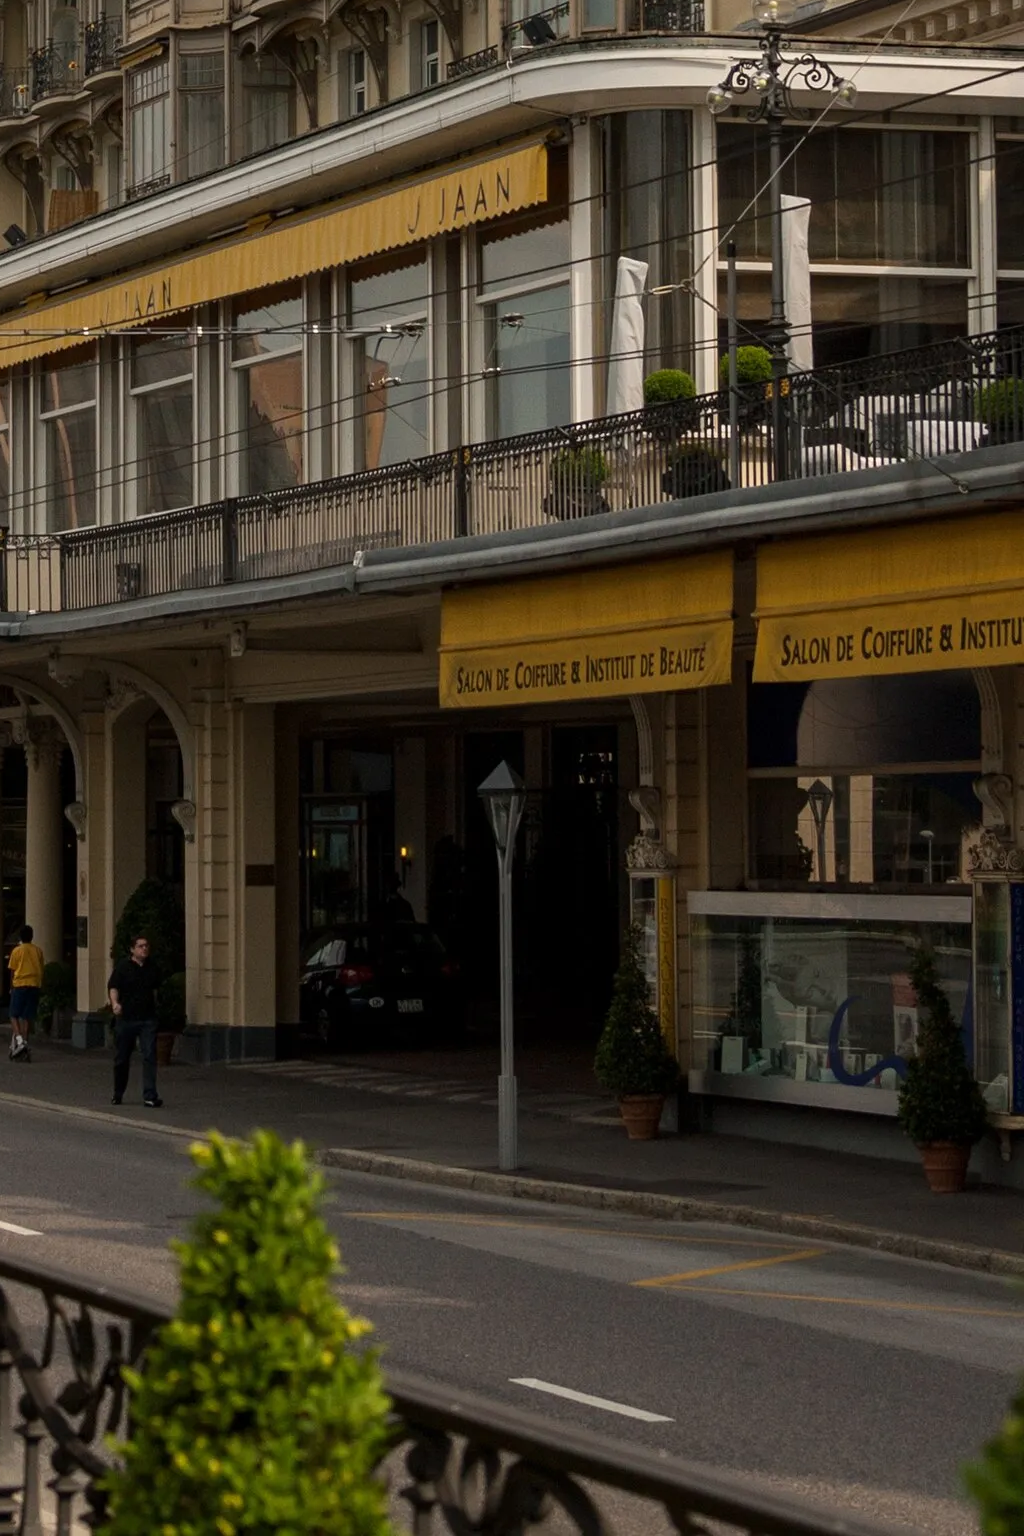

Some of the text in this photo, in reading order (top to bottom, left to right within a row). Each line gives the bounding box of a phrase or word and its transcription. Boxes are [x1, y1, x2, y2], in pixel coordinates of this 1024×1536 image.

[438, 167, 509, 225] JAAN
[781, 616, 1024, 666] SALON DE COIFFURE & INSTITU
[456, 642, 706, 694] SALON DE COIFFURE & INSTITUT DE BEAUTÉ
